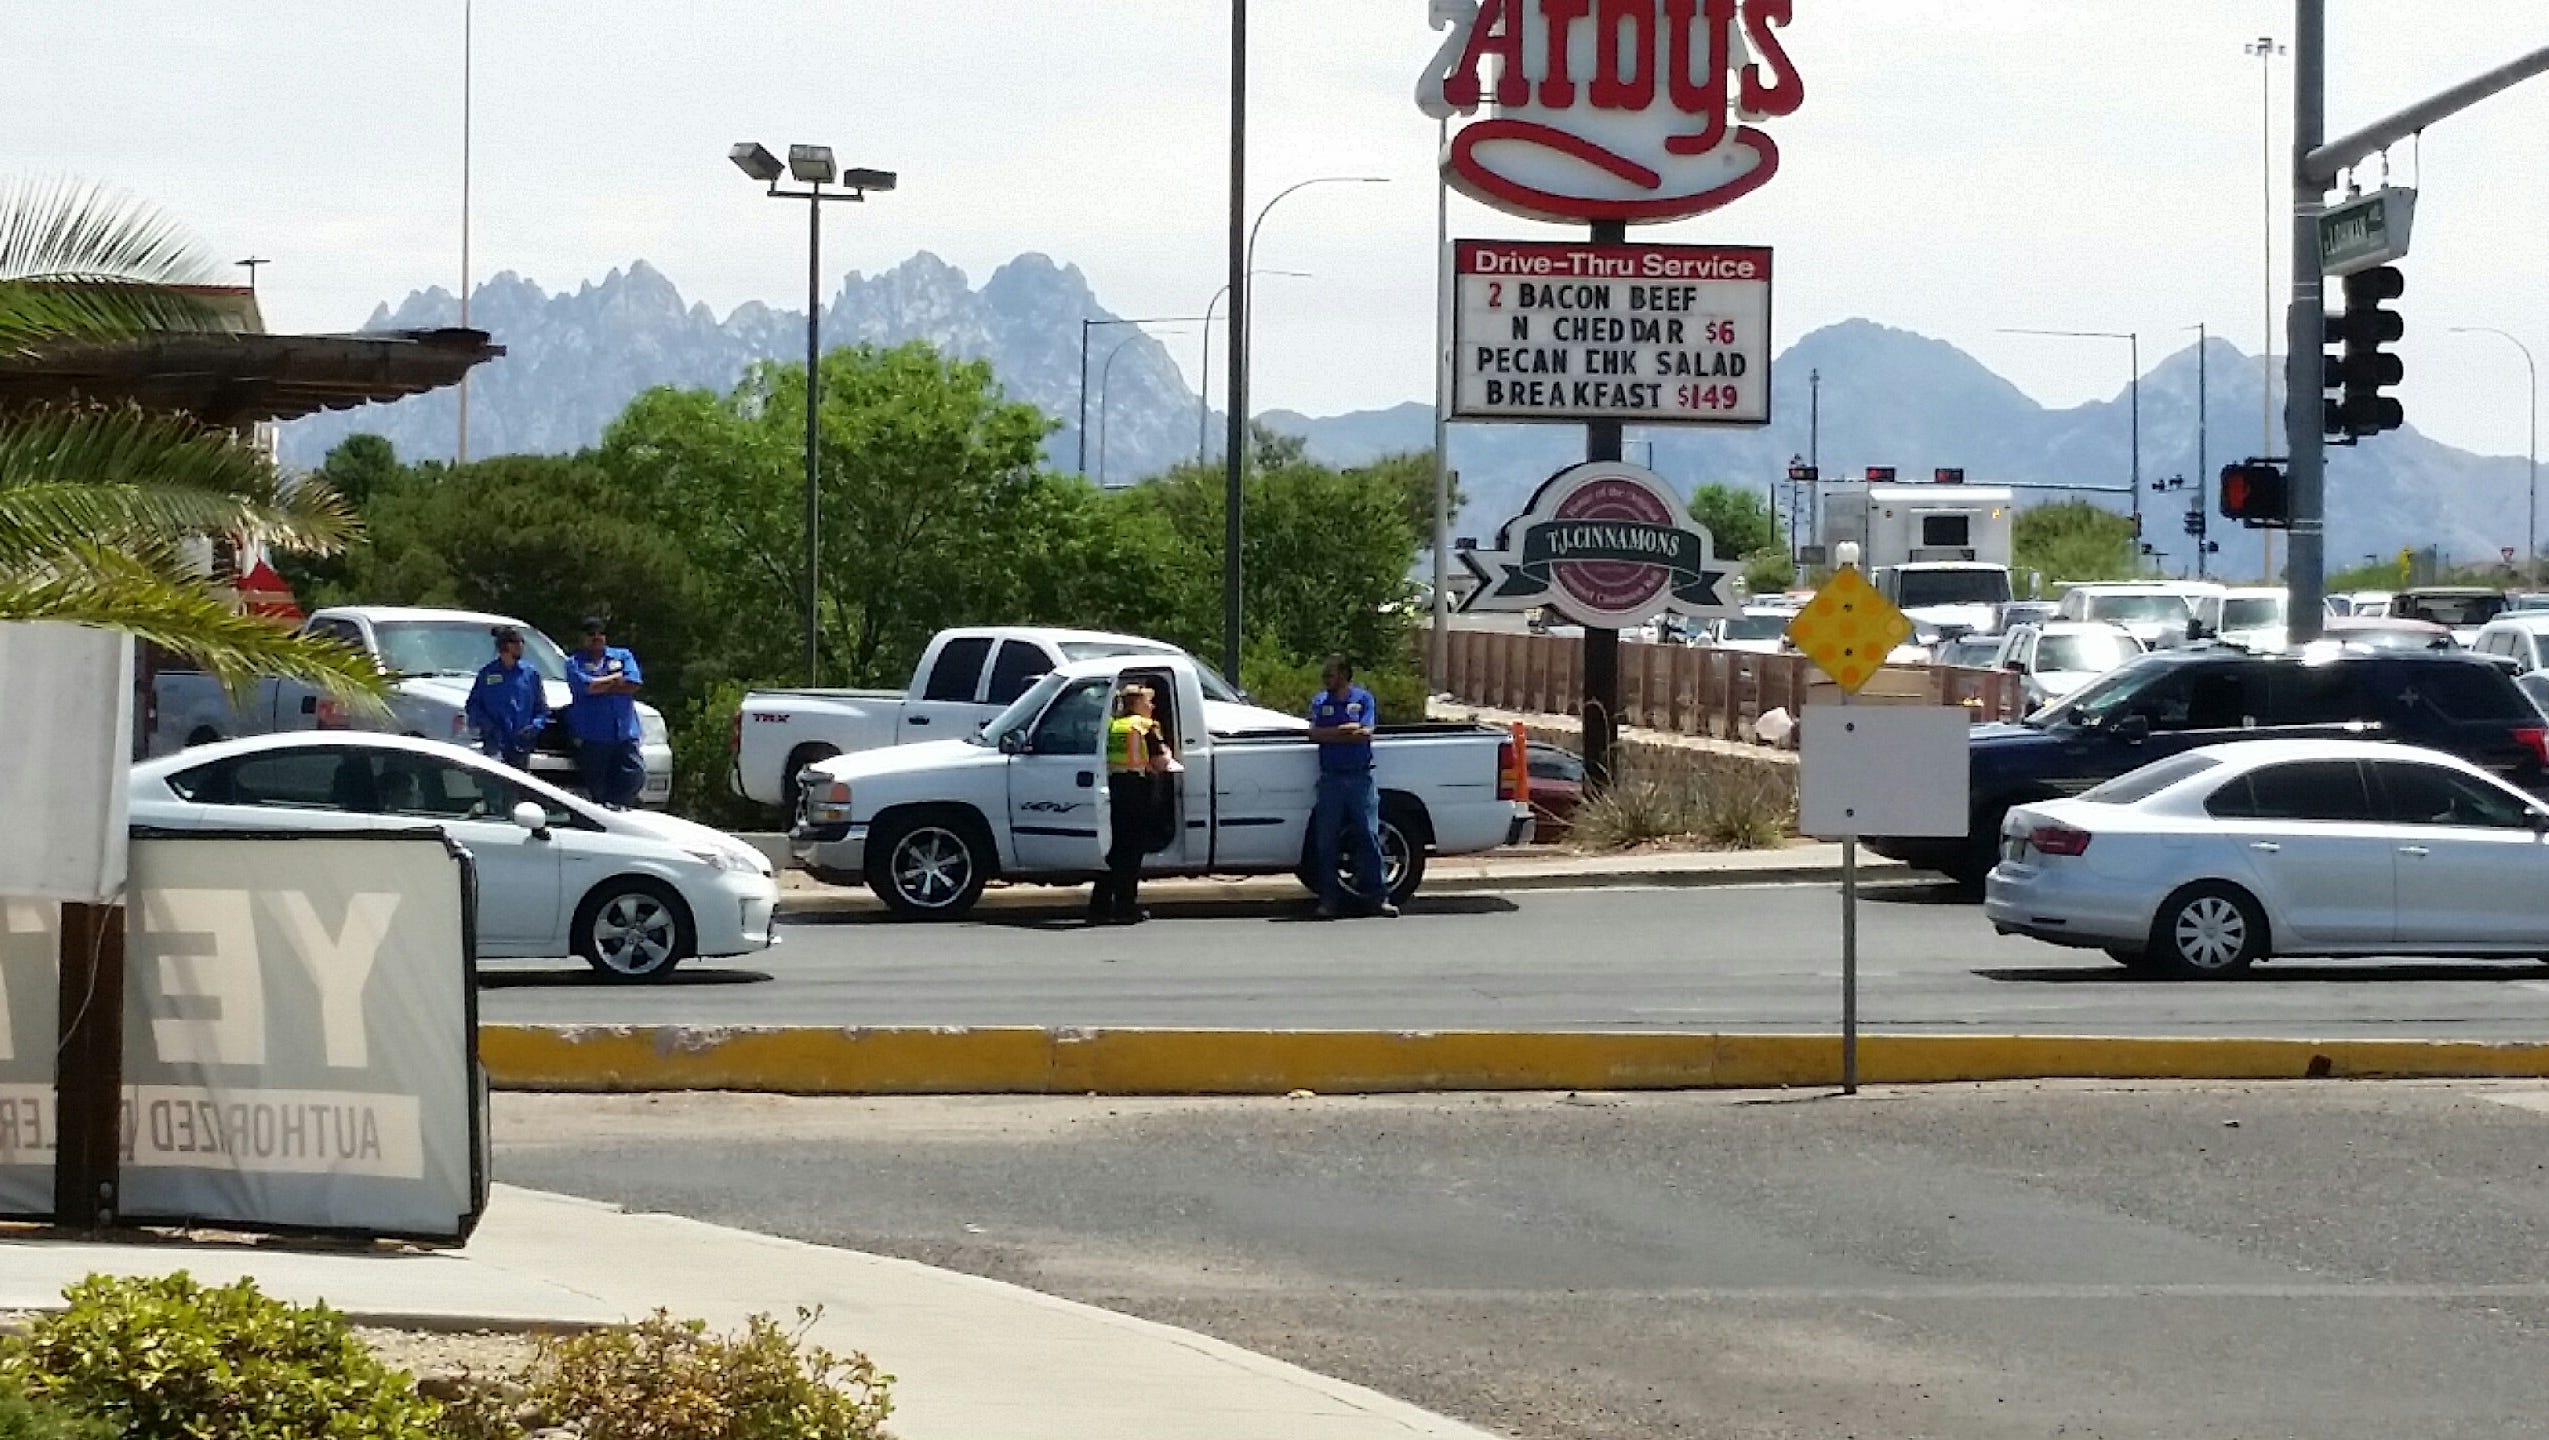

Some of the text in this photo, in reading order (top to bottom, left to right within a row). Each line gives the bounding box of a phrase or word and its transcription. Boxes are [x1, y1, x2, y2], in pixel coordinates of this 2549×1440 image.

[1443, 0, 1804, 155] Arbys
[1475, 250, 1756, 278] Drive-Thru Service
[1488, 282, 1697, 312] 2 BACON BEEF
[1512, 315, 1735, 345] N CHEDDAR $6
[1477, 346, 1746, 378] PECAN CHK SALAD
[1487, 380, 1662, 409] BREAKFAST
